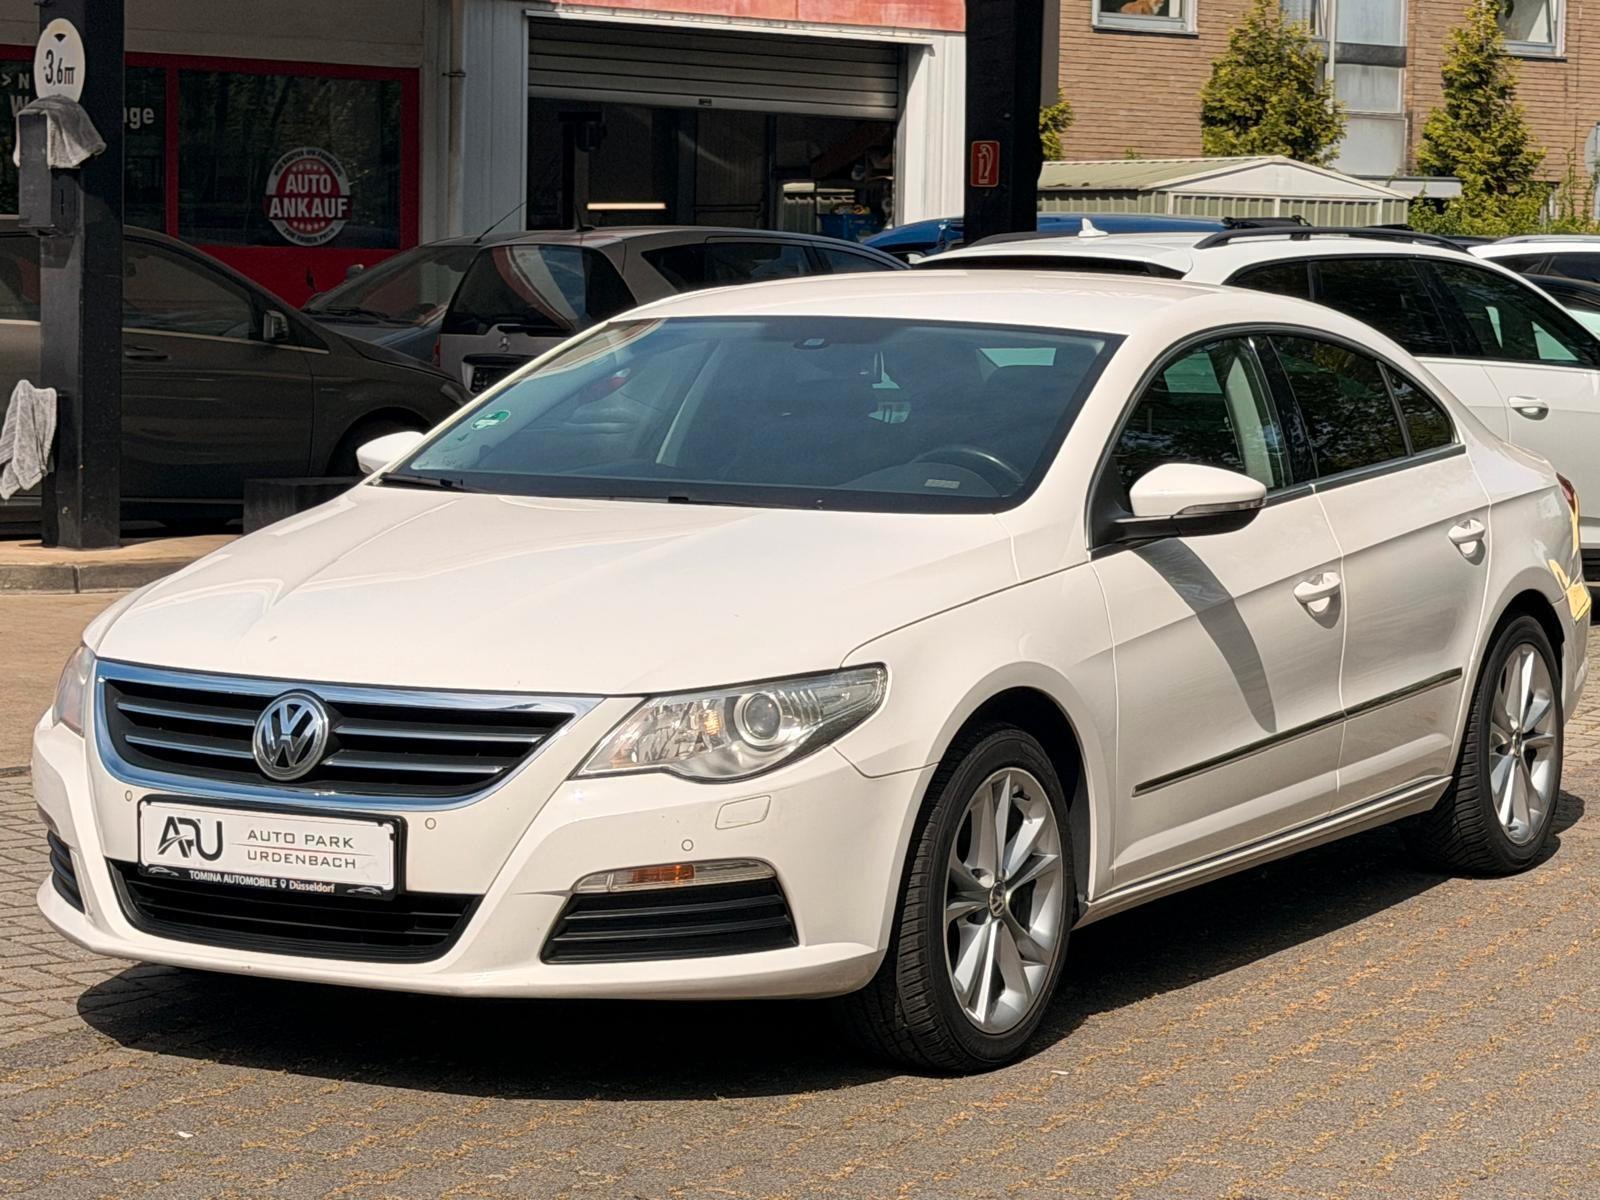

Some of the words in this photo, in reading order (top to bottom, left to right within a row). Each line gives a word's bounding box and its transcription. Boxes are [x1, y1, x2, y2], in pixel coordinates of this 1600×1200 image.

[285, 174, 331, 194] AUTO
[269, 197, 348, 218] ANKAUF
[247, 829, 296, 844] AUTO
[304, 834, 355, 849] PARK
[247, 850, 356, 869] URDENBACH
[189, 870, 222, 883] TOMINA
[223, 873, 278, 889] AUTOMOBILE
[289, 880, 336, 894] Düsseldorf
